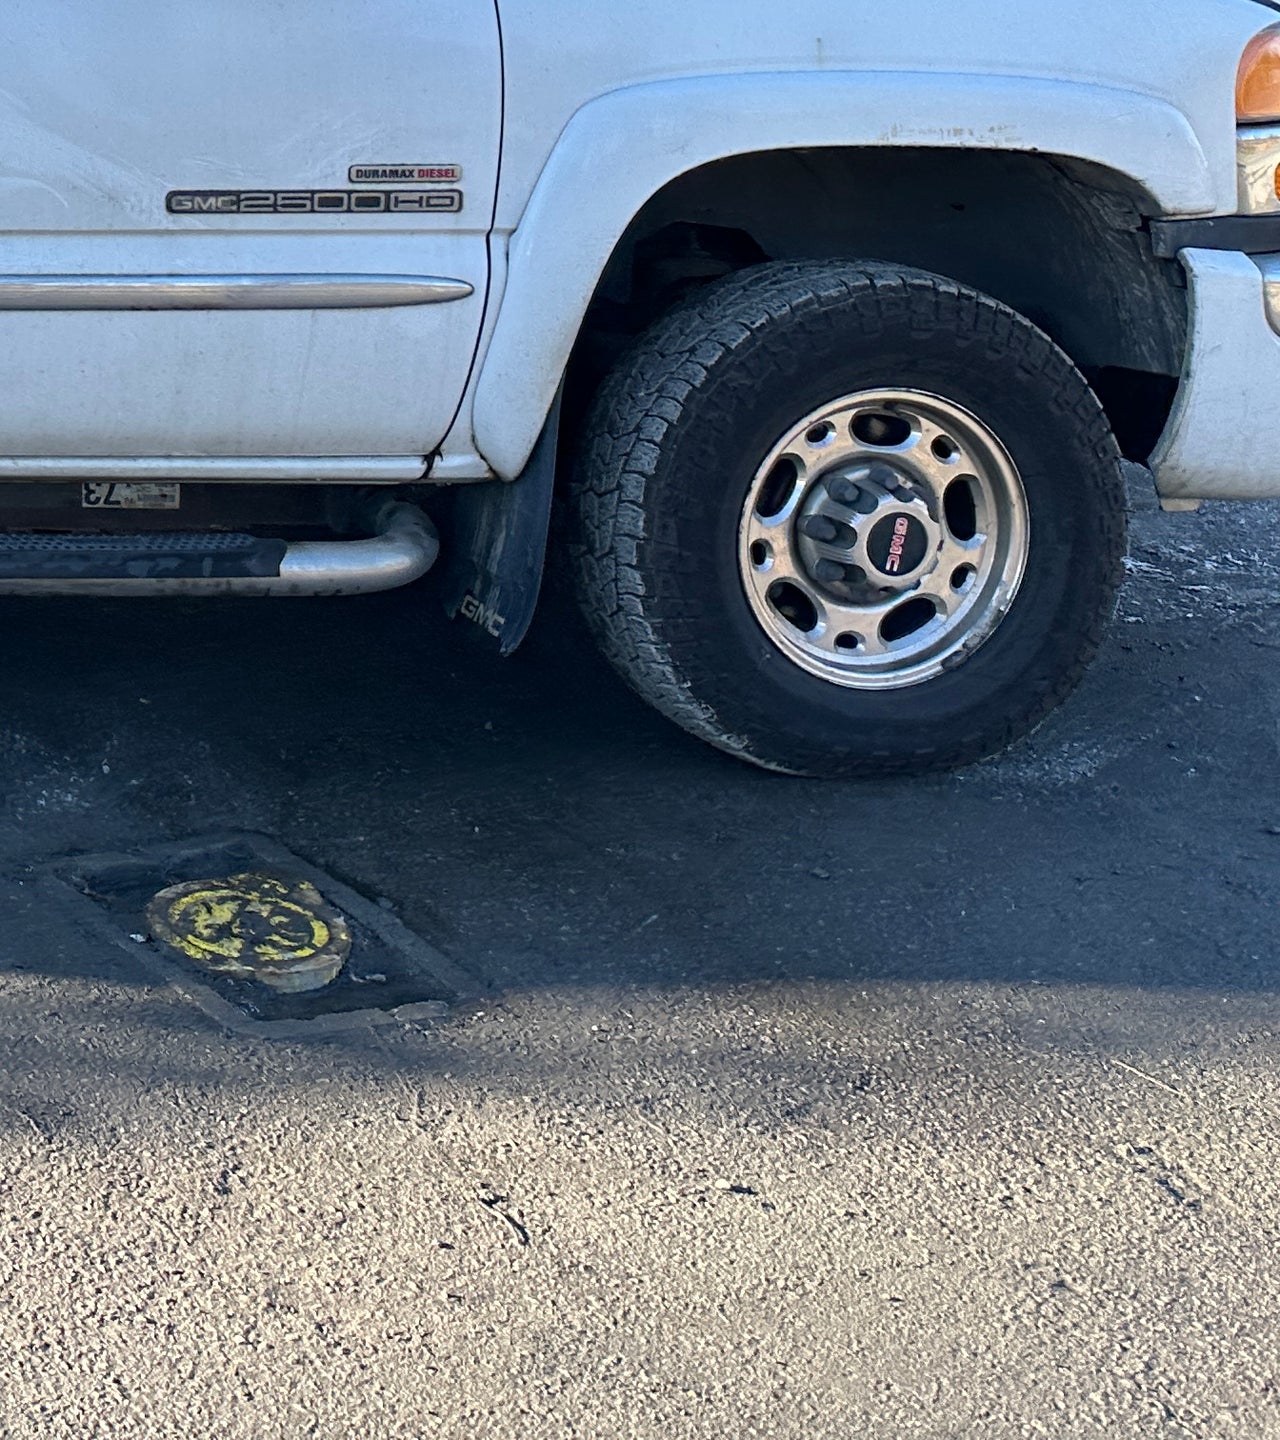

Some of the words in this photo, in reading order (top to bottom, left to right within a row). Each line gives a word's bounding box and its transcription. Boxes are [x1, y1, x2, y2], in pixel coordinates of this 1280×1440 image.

[355, 168, 416, 179] DURAMAX
[416, 168, 458, 179] DIESEL
[884, 516, 909, 572] GMC
[460, 594, 506, 638] GMC
